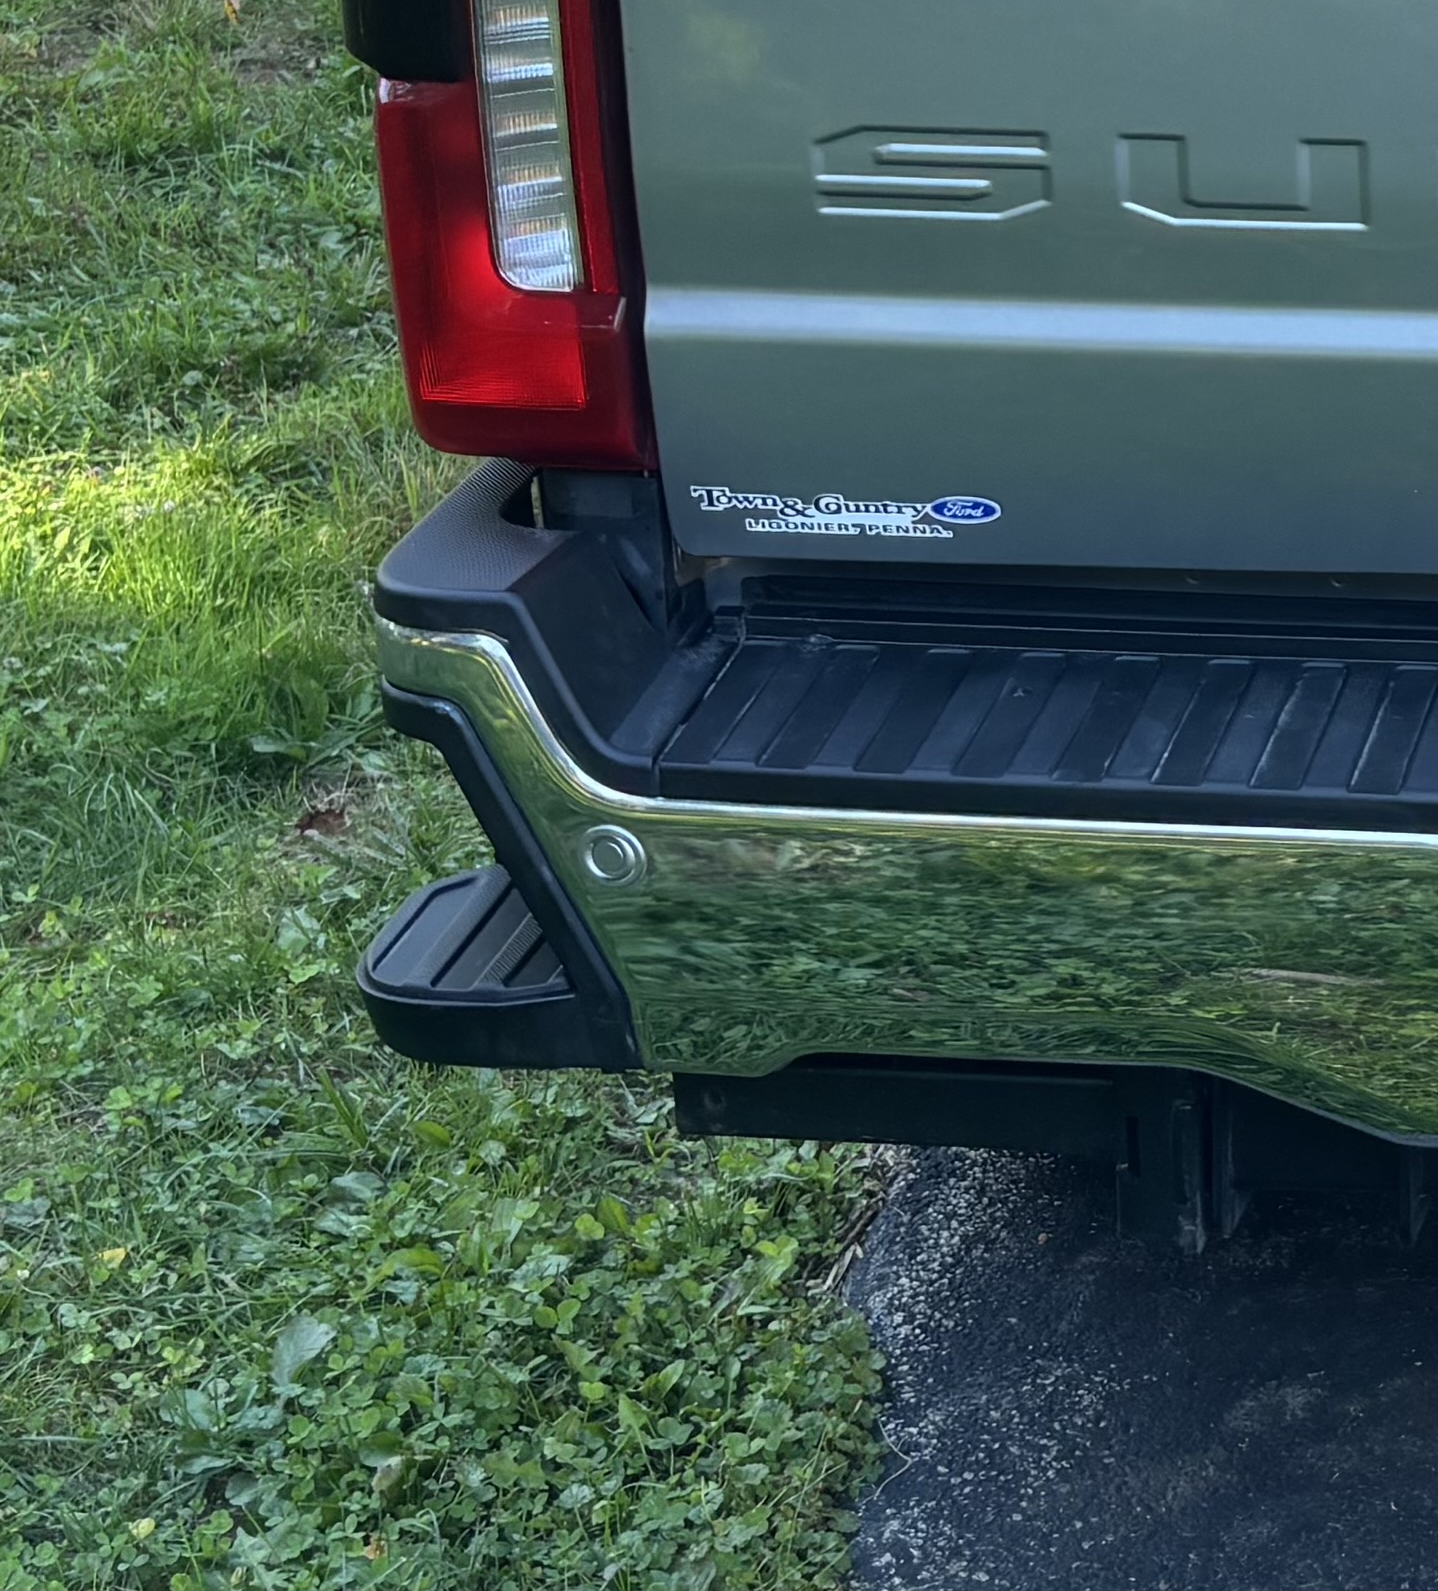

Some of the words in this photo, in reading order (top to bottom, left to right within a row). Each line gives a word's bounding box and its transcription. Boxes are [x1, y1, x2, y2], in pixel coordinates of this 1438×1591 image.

[690, 485, 780, 511] Town
[778, 498, 815, 519] &
[746, 518, 862, 535] LIGONIER,
[867, 524, 953, 538] PENNA.
